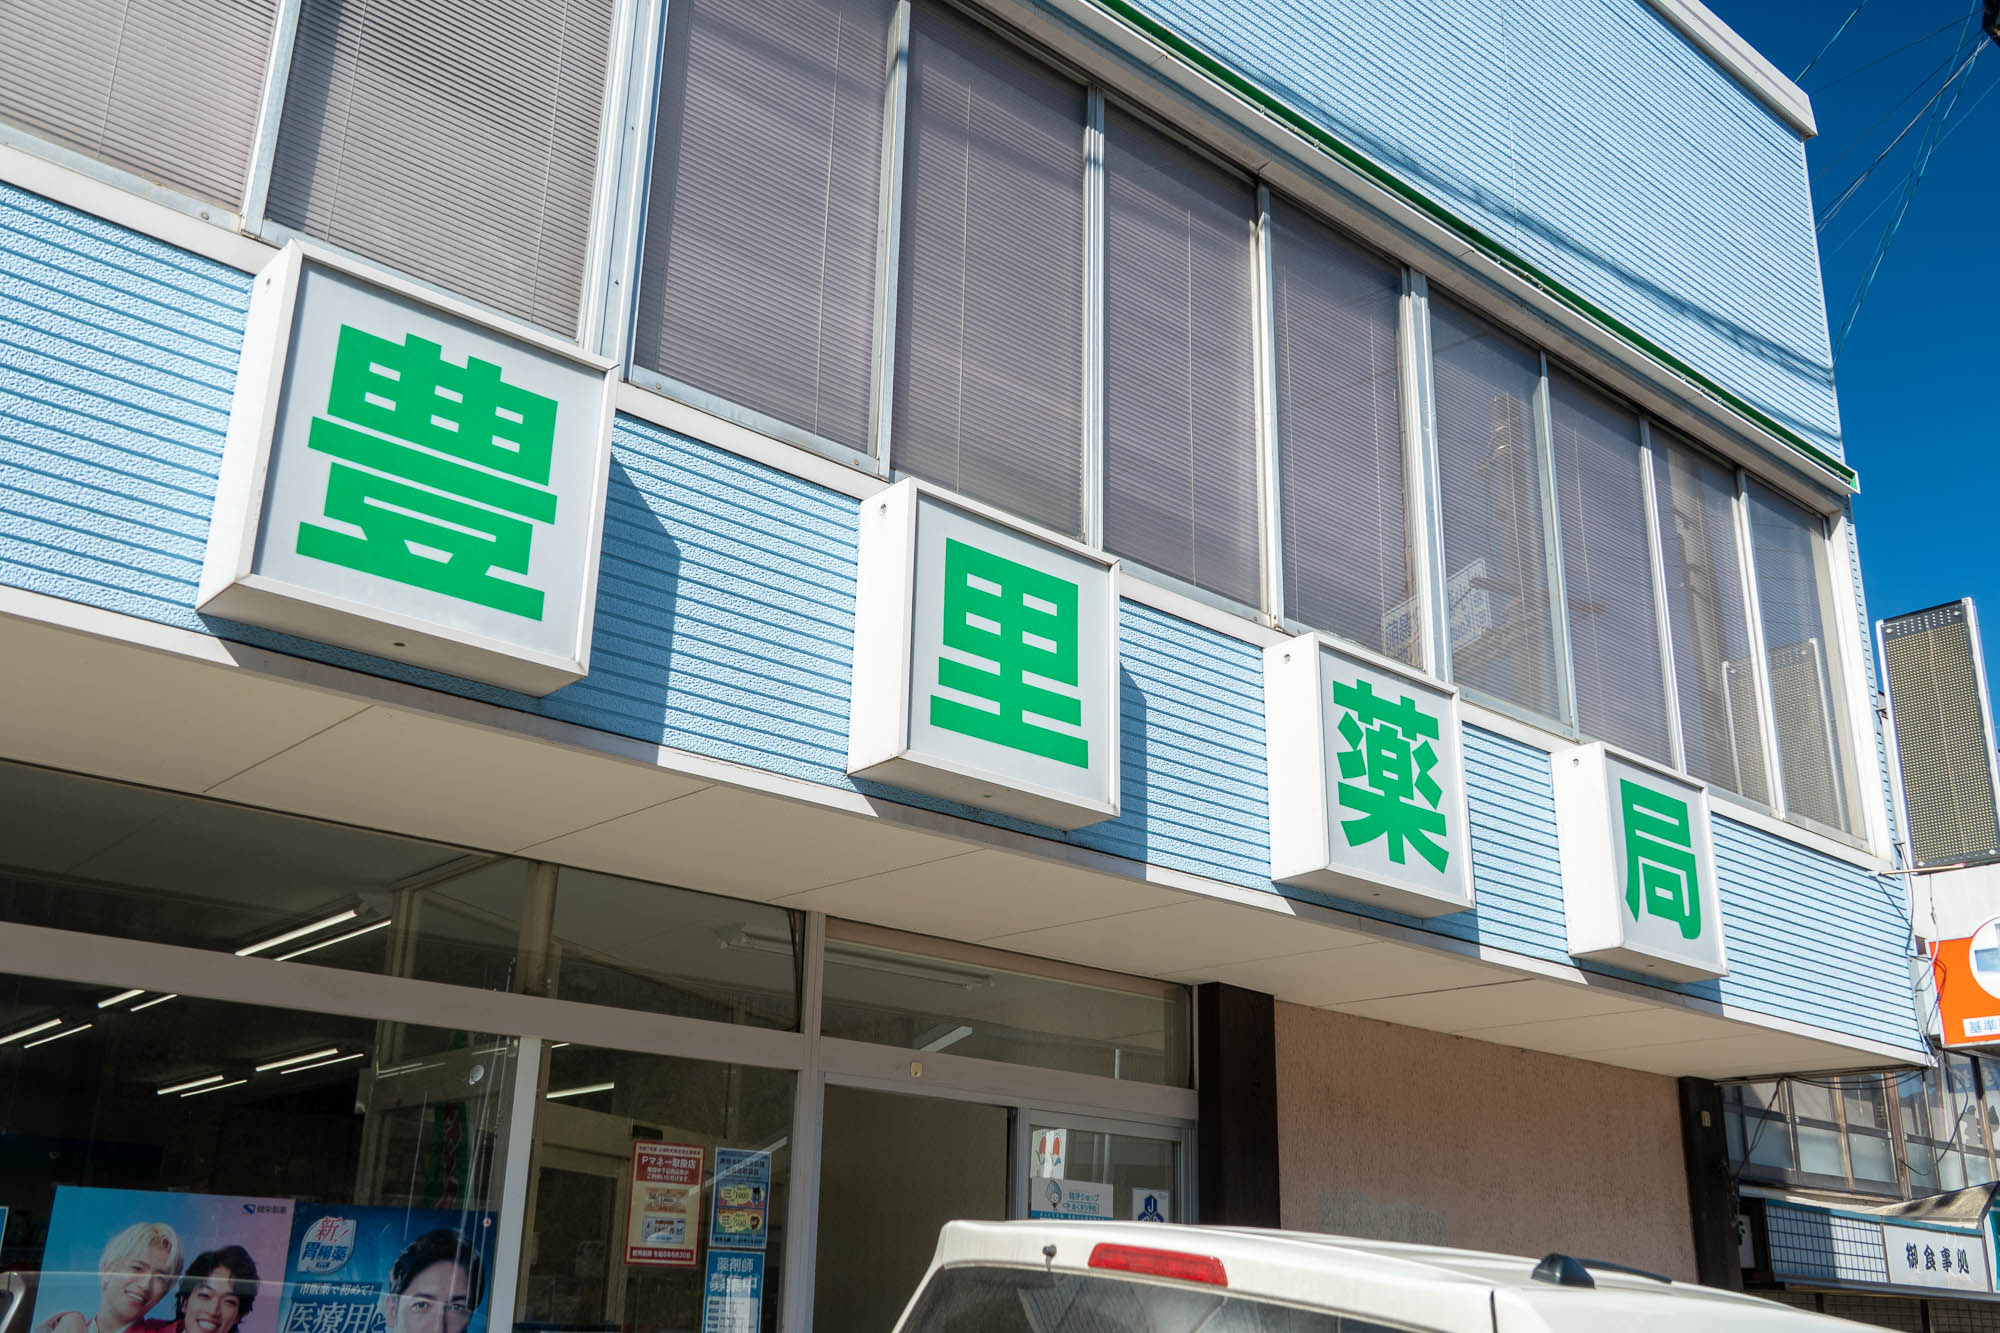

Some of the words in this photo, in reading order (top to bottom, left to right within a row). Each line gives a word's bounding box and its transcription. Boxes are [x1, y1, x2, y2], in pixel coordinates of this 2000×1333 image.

[1968, 1016, 2000, 1034] 基準
[302, 1242, 349, 1261] 胃腸薬
[717, 1256, 754, 1272] 薬剤師
